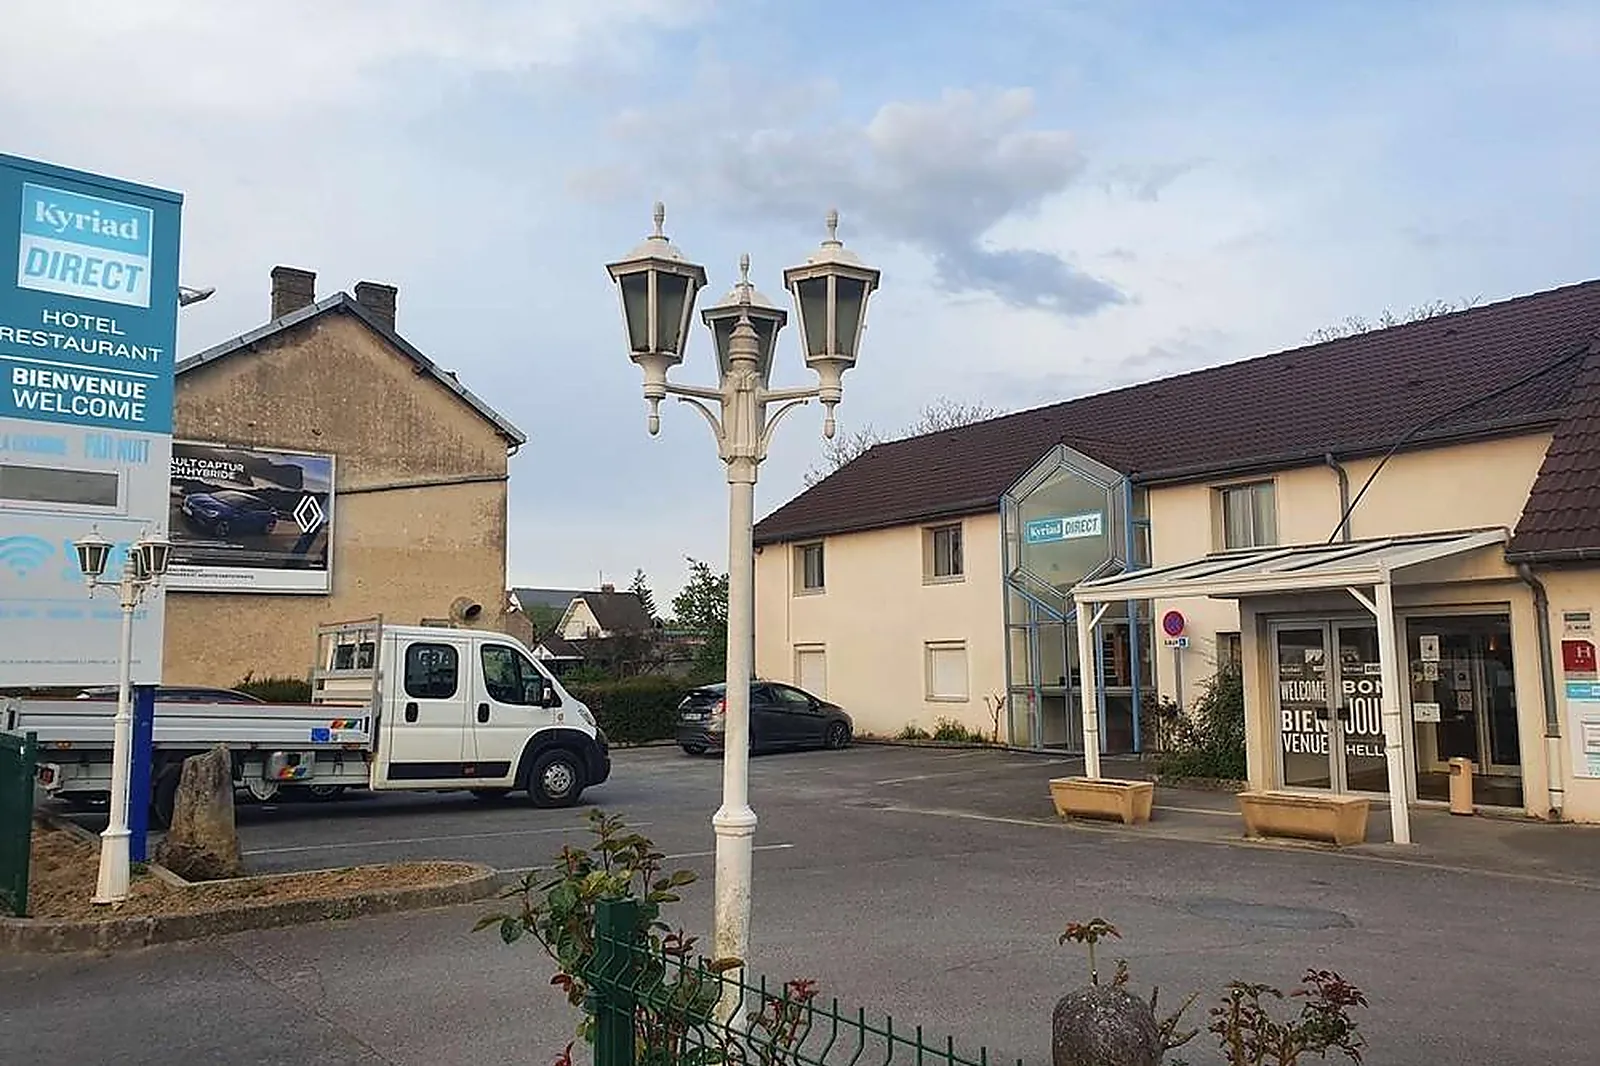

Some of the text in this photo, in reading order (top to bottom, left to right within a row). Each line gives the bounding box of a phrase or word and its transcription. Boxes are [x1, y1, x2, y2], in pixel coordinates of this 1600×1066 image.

[34, 199, 139, 242] Kyriad
[24, 246, 144, 294] DIRECT
[42, 309, 126, 336] HOTEL
[0, 326, 163, 362] RESTAURANT
[12, 366, 146, 400] BIENVENUE
[12, 388, 146, 422] WELCOME
[186, 467, 235, 480] HYBRIDE
[198, 460, 244, 473] CAPTUR
[1280, 680, 1327, 701] WELCOME
[1281, 709, 1329, 733] BIEN
[1282, 733, 1329, 755] VENUE
